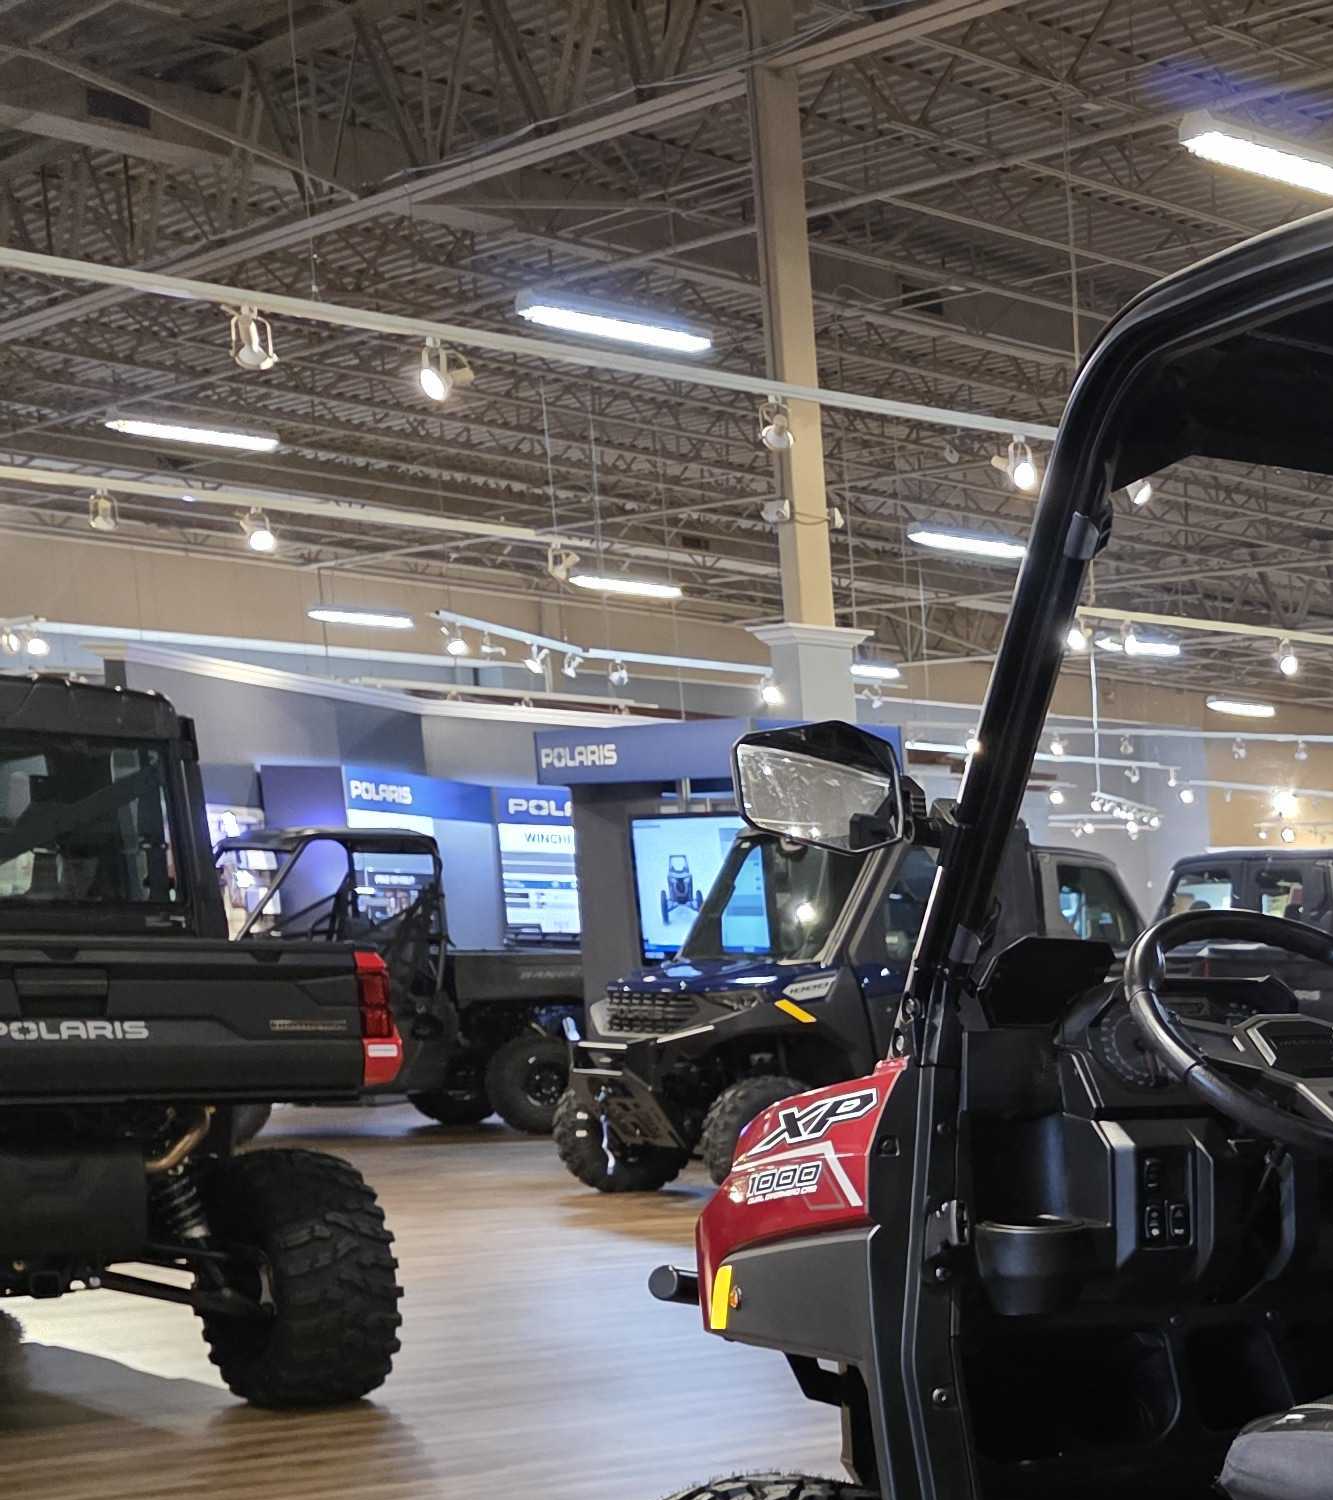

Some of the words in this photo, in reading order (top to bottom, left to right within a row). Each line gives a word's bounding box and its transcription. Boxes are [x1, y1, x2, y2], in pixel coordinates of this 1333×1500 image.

[541, 744, 618, 768] POLARIS
[350, 779, 412, 805] POLARIS
[747, 1088, 878, 1156] XP
[747, 1161, 823, 1198] 1000
